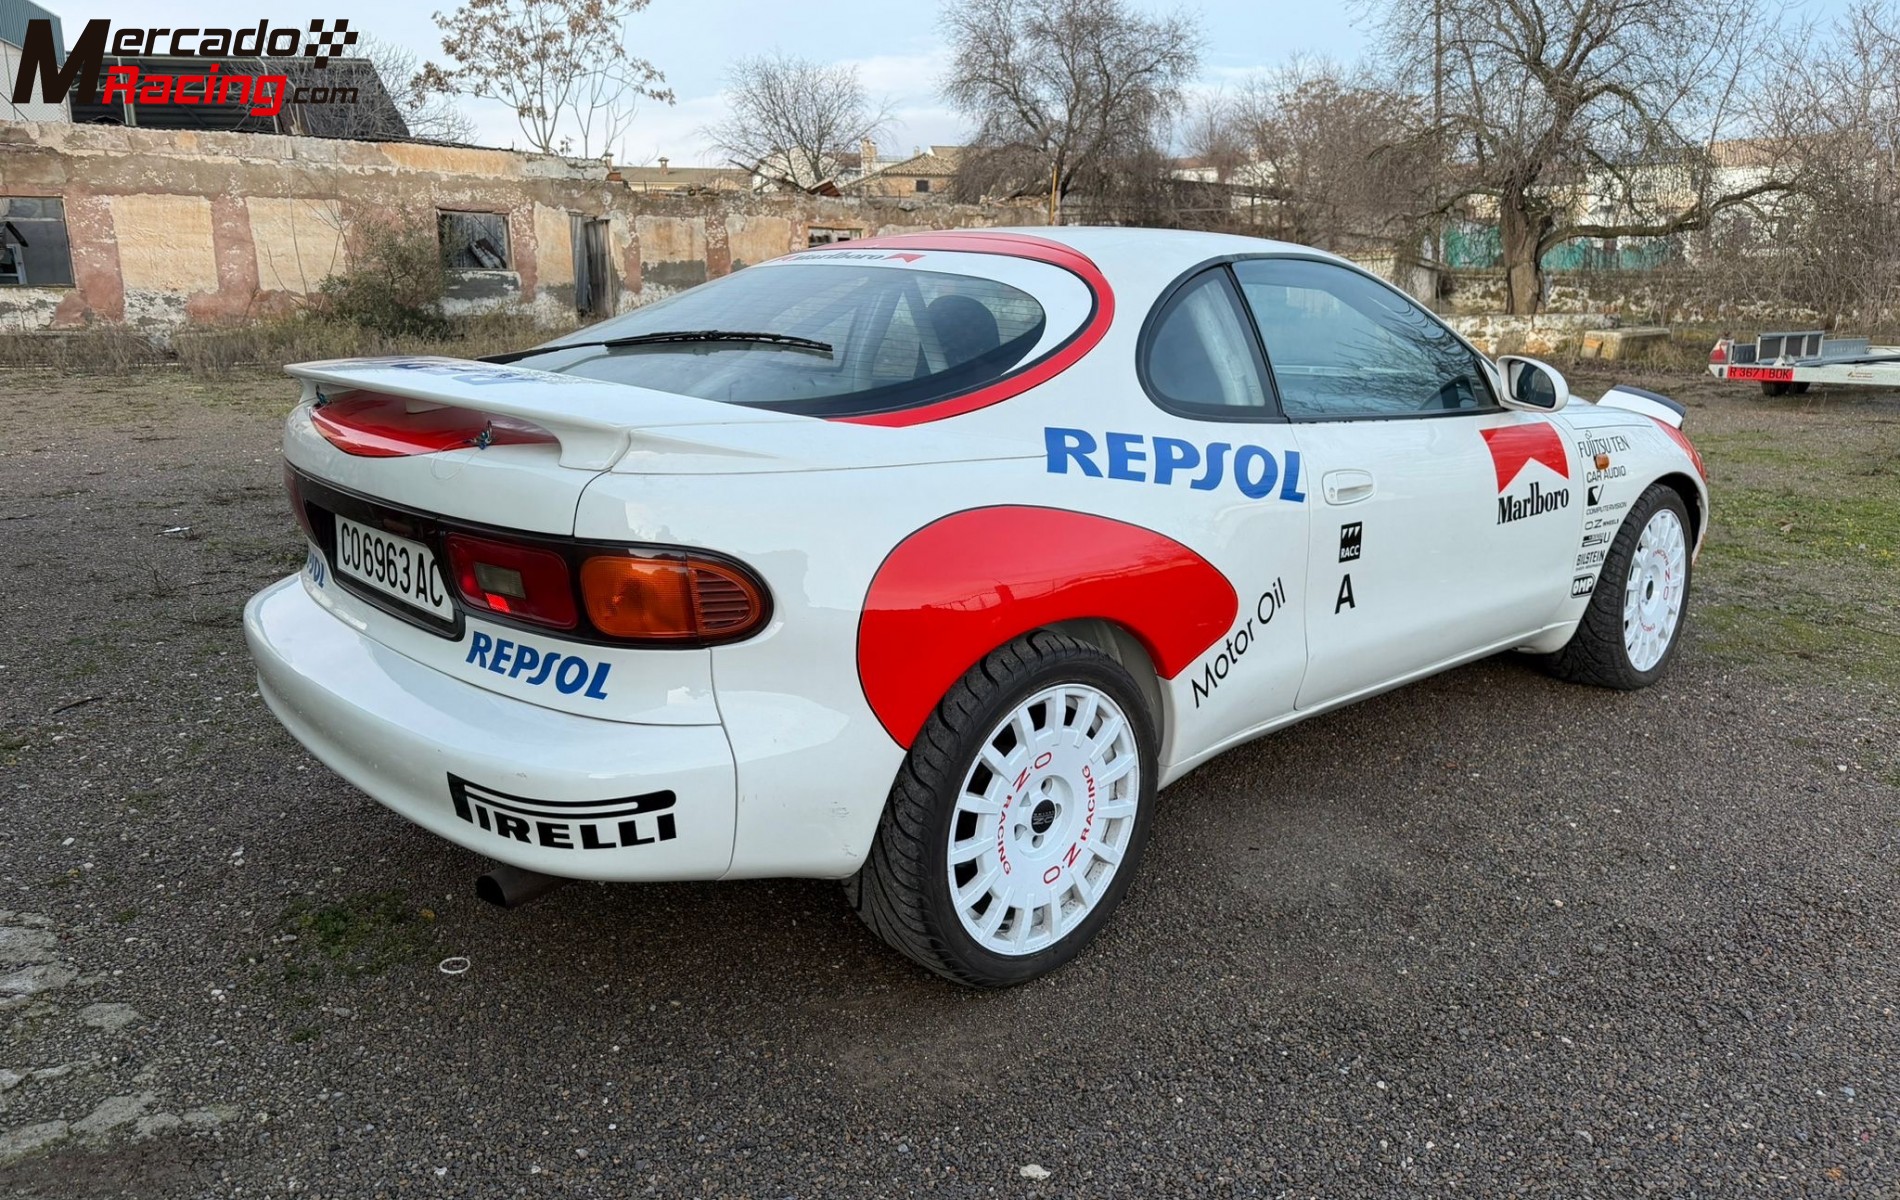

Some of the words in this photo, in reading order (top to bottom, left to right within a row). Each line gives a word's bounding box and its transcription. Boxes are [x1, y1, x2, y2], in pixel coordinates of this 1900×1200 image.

[1730, 368, 1738, 377] R
[1739, 368, 1765, 378] 3671
[1044, 426, 1306, 503] REPSOL
[1578, 437, 1612, 458] FUJITSU
[1610, 435, 1631, 452] TEN
[1586, 469, 1602, 483] CAR
[1603, 465, 1626, 480] AUDIO
[1497, 481, 1569, 525] Marlboro
[1340, 545, 1360, 559] RACC
[1576, 549, 1606, 566] BILSTEIN
[1335, 573, 1356, 614] A
[1573, 577, 1594, 595] OMP
[1191, 617, 1257, 708] Motor
[1257, 577, 1286, 625] Oil
[465, 630, 612, 700] REPSOL
[447, 771, 677, 849] PIRELLI
[1080, 765, 1096, 841] RACING
[998, 794, 1012, 875] RACING
